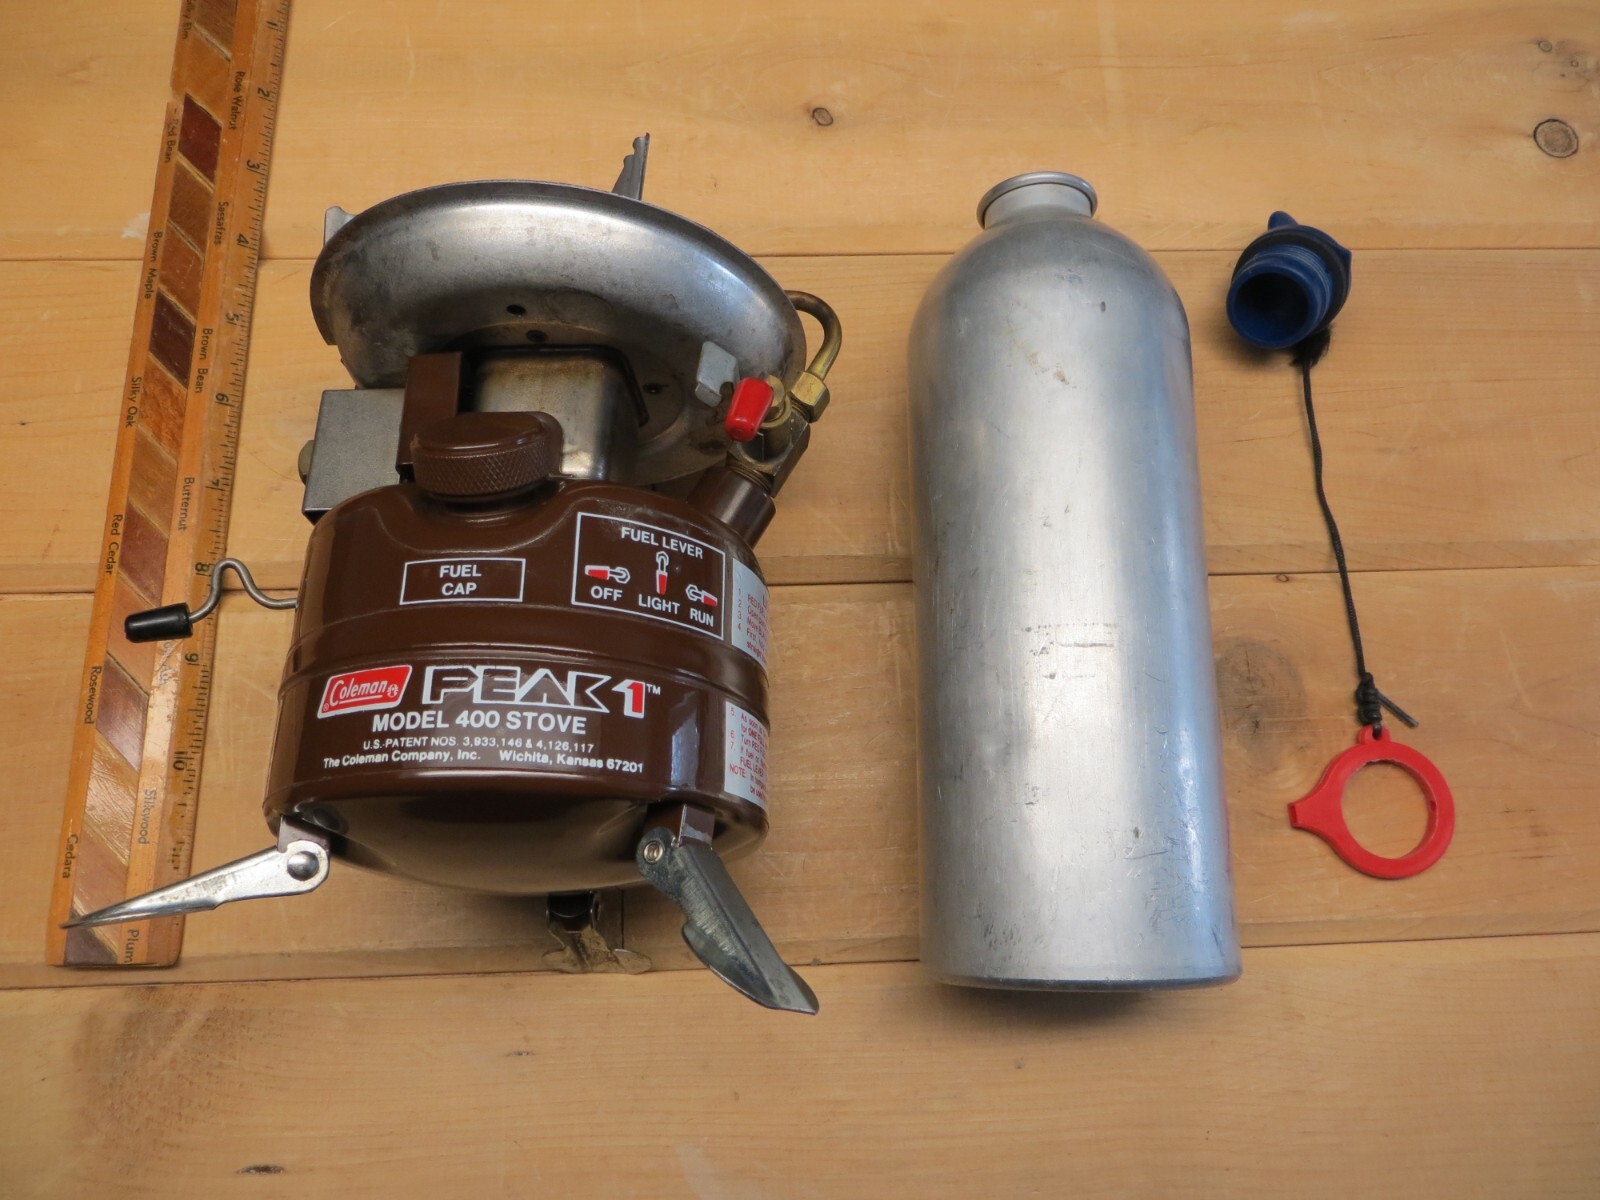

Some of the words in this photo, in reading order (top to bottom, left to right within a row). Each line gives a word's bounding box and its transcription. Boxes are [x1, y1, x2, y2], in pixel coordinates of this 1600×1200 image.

[181, 22, 193, 40] Elm
[233, 71, 246, 92] Rose
[257, 87, 270, 98] 2
[229, 96, 242, 130] Walnut
[247, 160, 260, 171] 3
[213, 201, 229, 245] Sassafras
[149, 231, 163, 262] Brown
[236, 233, 249, 246] 4
[144, 268, 157, 299] Maple
[226, 311, 240, 324] 5
[200, 328, 213, 360] Brown
[127, 377, 142, 403] Silky
[194, 368, 208, 393] Bean
[215, 393, 229, 403] 6
[125, 406, 138, 428] Oak
[178, 477, 195, 531] Butternut
[111, 514, 123, 536] Red
[621, 526, 659, 546] FUEL
[662, 536, 704, 559] LEVER
[105, 542, 119, 575] Cedar
[195, 562, 209, 573] 8
[439, 564, 482, 578] FUEL
[441, 583, 478, 596] CAP
[590, 585, 623, 601] OFF
[638, 595, 681, 615] LIGHT
[689, 608, 714, 627] RUN
[184, 653, 199, 663] 9
[84, 666, 102, 724] Rosewood
[329, 678, 388, 706] Coleman
[422, 665, 612, 713] PEAK
[372, 710, 449, 732] MODEL
[455, 710, 500, 728] 400
[506, 711, 587, 734] STOVE
[385, 736, 428, 748] PATENT
[431, 736, 459, 746] NOS.
[463, 737, 522, 748] 3,933,146
[526, 739, 533, 749] &
[536, 740, 594, 753] 4,126,117
[173, 751, 188, 771] 10
[323, 757, 340, 769] The
[342, 752, 389, 767] Coleman
[391, 750, 454, 763] Company,
[457, 750, 481, 761] Inc.
[499, 750, 553, 765] Wichita,
[556, 753, 604, 769] Kansas
[606, 758, 644, 773] 67201
[62, 834, 79, 879] Cedara
[124, 929, 140, 963] Plum
